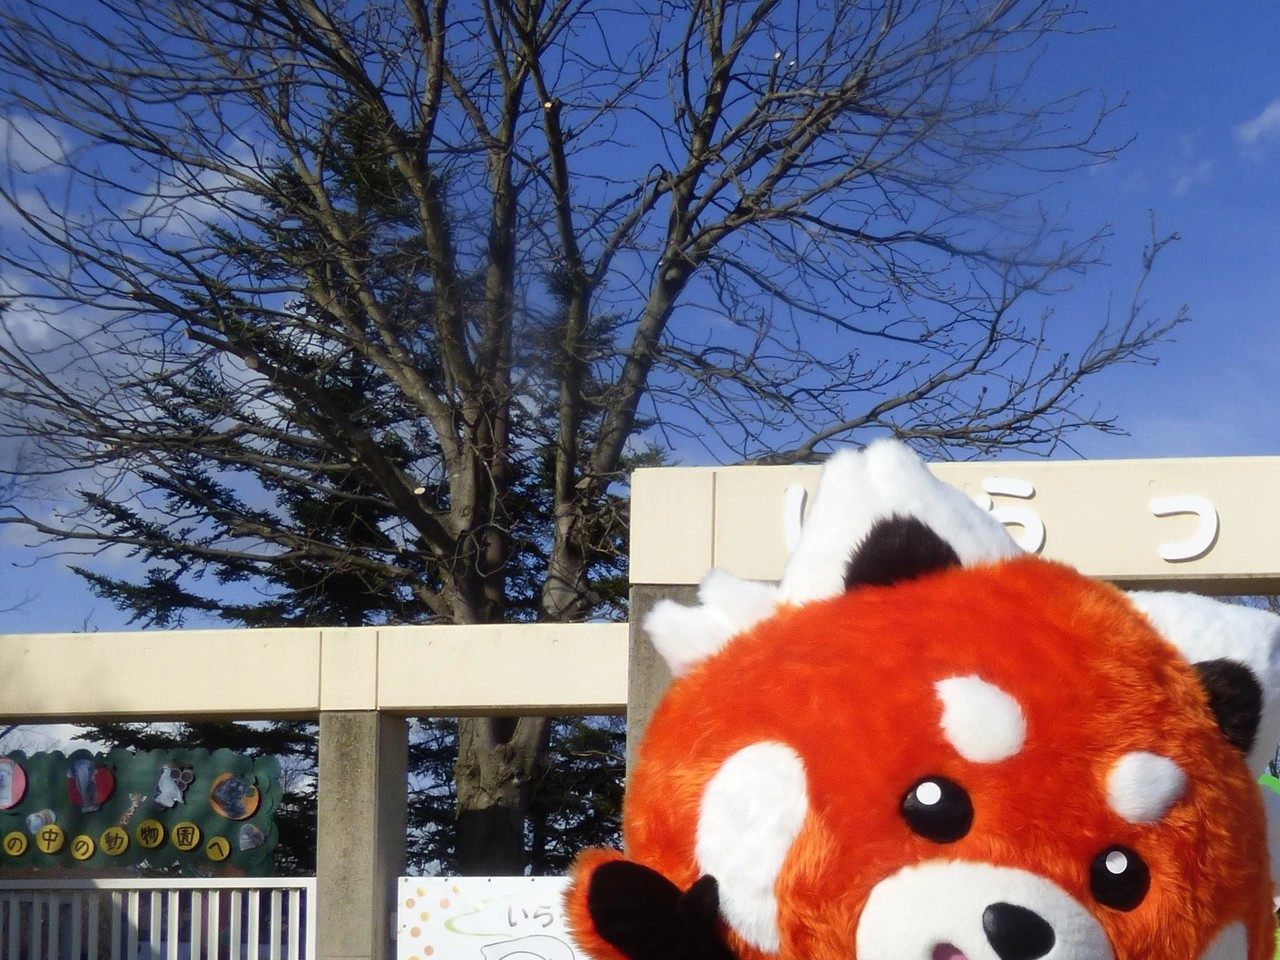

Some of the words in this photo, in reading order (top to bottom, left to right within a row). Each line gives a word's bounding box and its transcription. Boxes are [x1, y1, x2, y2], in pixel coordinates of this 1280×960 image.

[6, 820, 226, 857] の中の動物園へ
[507, 904, 562, 929] いら
